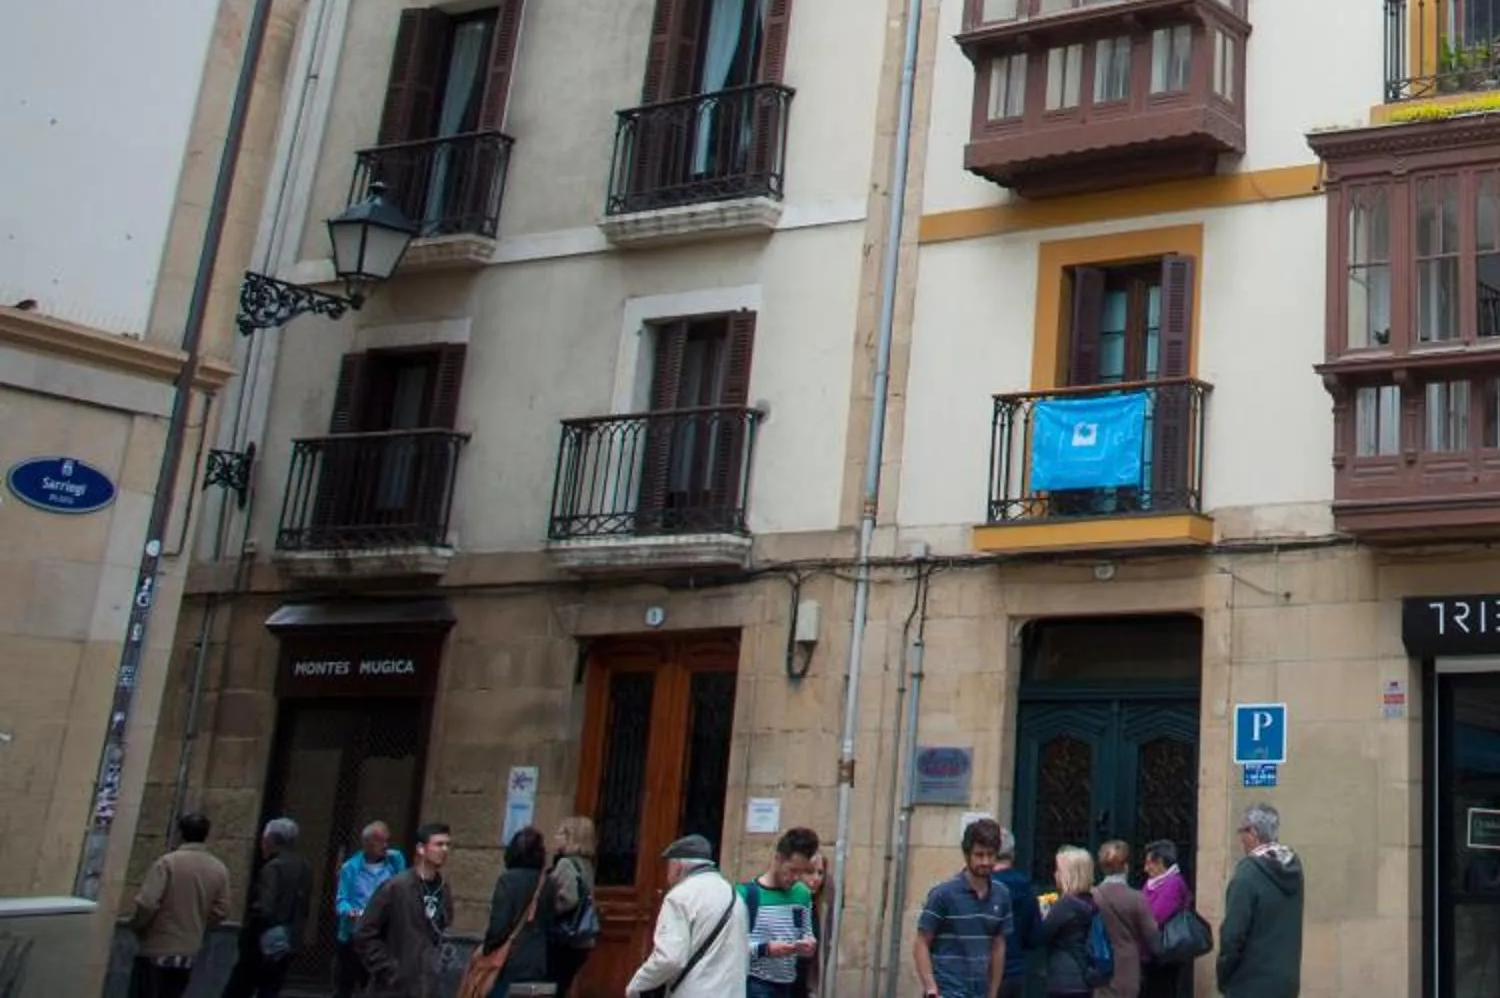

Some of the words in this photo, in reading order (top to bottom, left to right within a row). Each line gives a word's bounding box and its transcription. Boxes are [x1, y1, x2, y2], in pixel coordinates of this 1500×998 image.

[294, 661, 350, 675] MONTES
[360, 660, 414, 674] MUGICA
[1252, 711, 1273, 741] P
